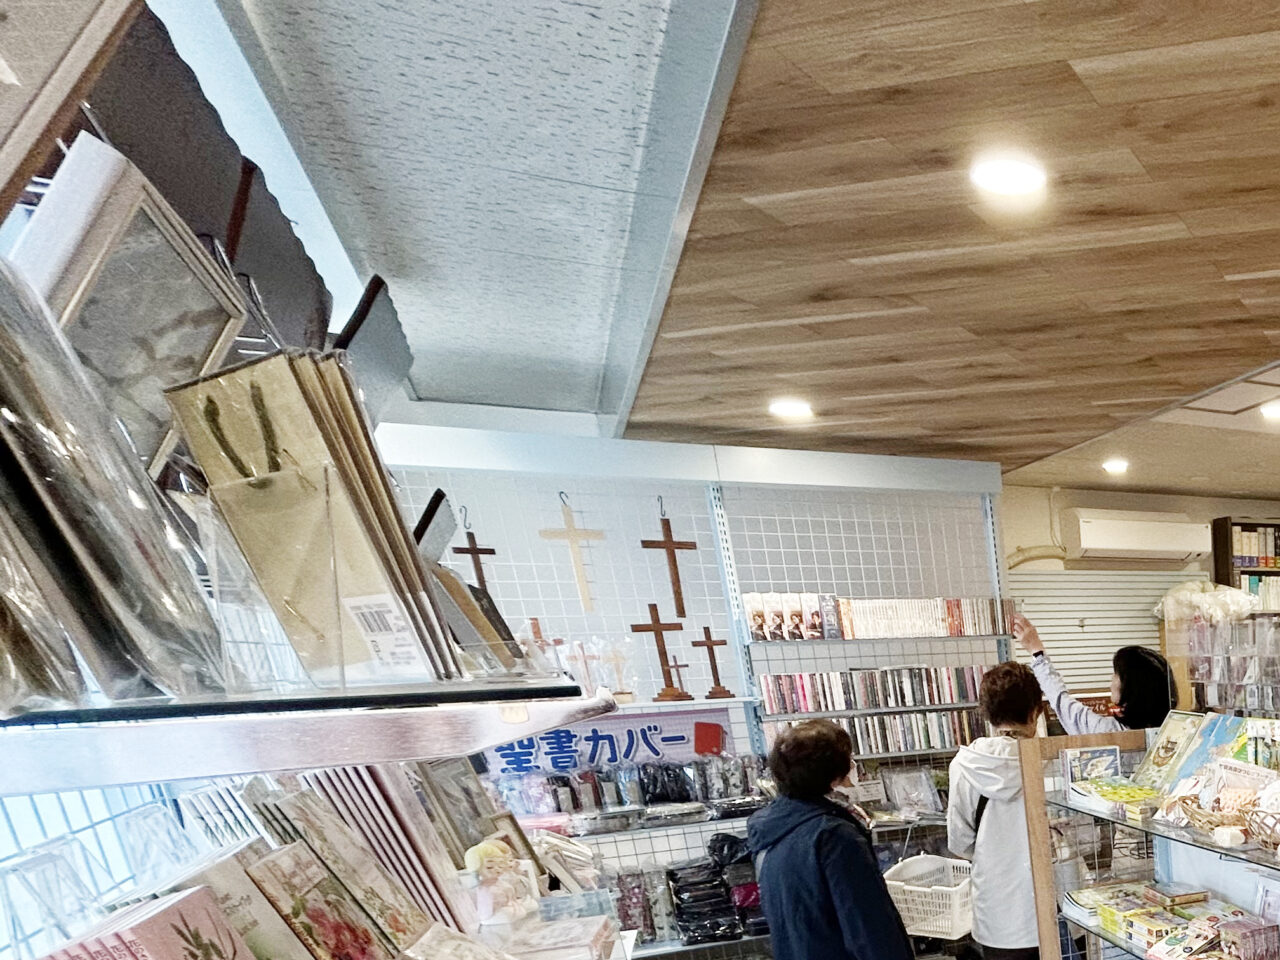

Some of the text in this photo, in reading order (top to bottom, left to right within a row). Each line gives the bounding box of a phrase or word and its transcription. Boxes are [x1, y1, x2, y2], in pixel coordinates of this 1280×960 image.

[494, 725, 687, 775] 聖書カバー
